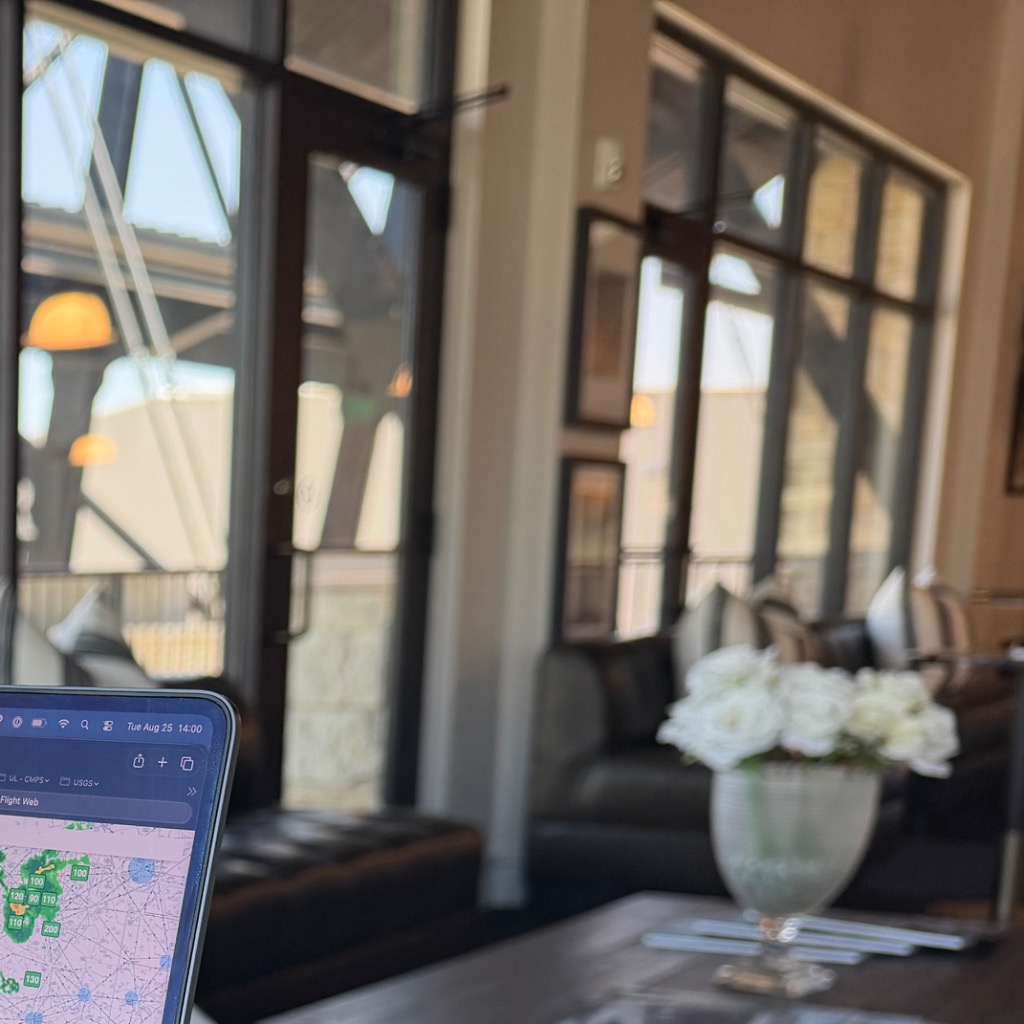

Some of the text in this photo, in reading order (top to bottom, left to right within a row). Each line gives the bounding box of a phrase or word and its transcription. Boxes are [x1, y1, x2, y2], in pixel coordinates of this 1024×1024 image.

[127, 721, 203, 734] Tue Aug 25 14:00
[24, 775, 44, 784] CMPS
[73, 778, 93, 787] USGS
[22, 797, 39, 806] Web
